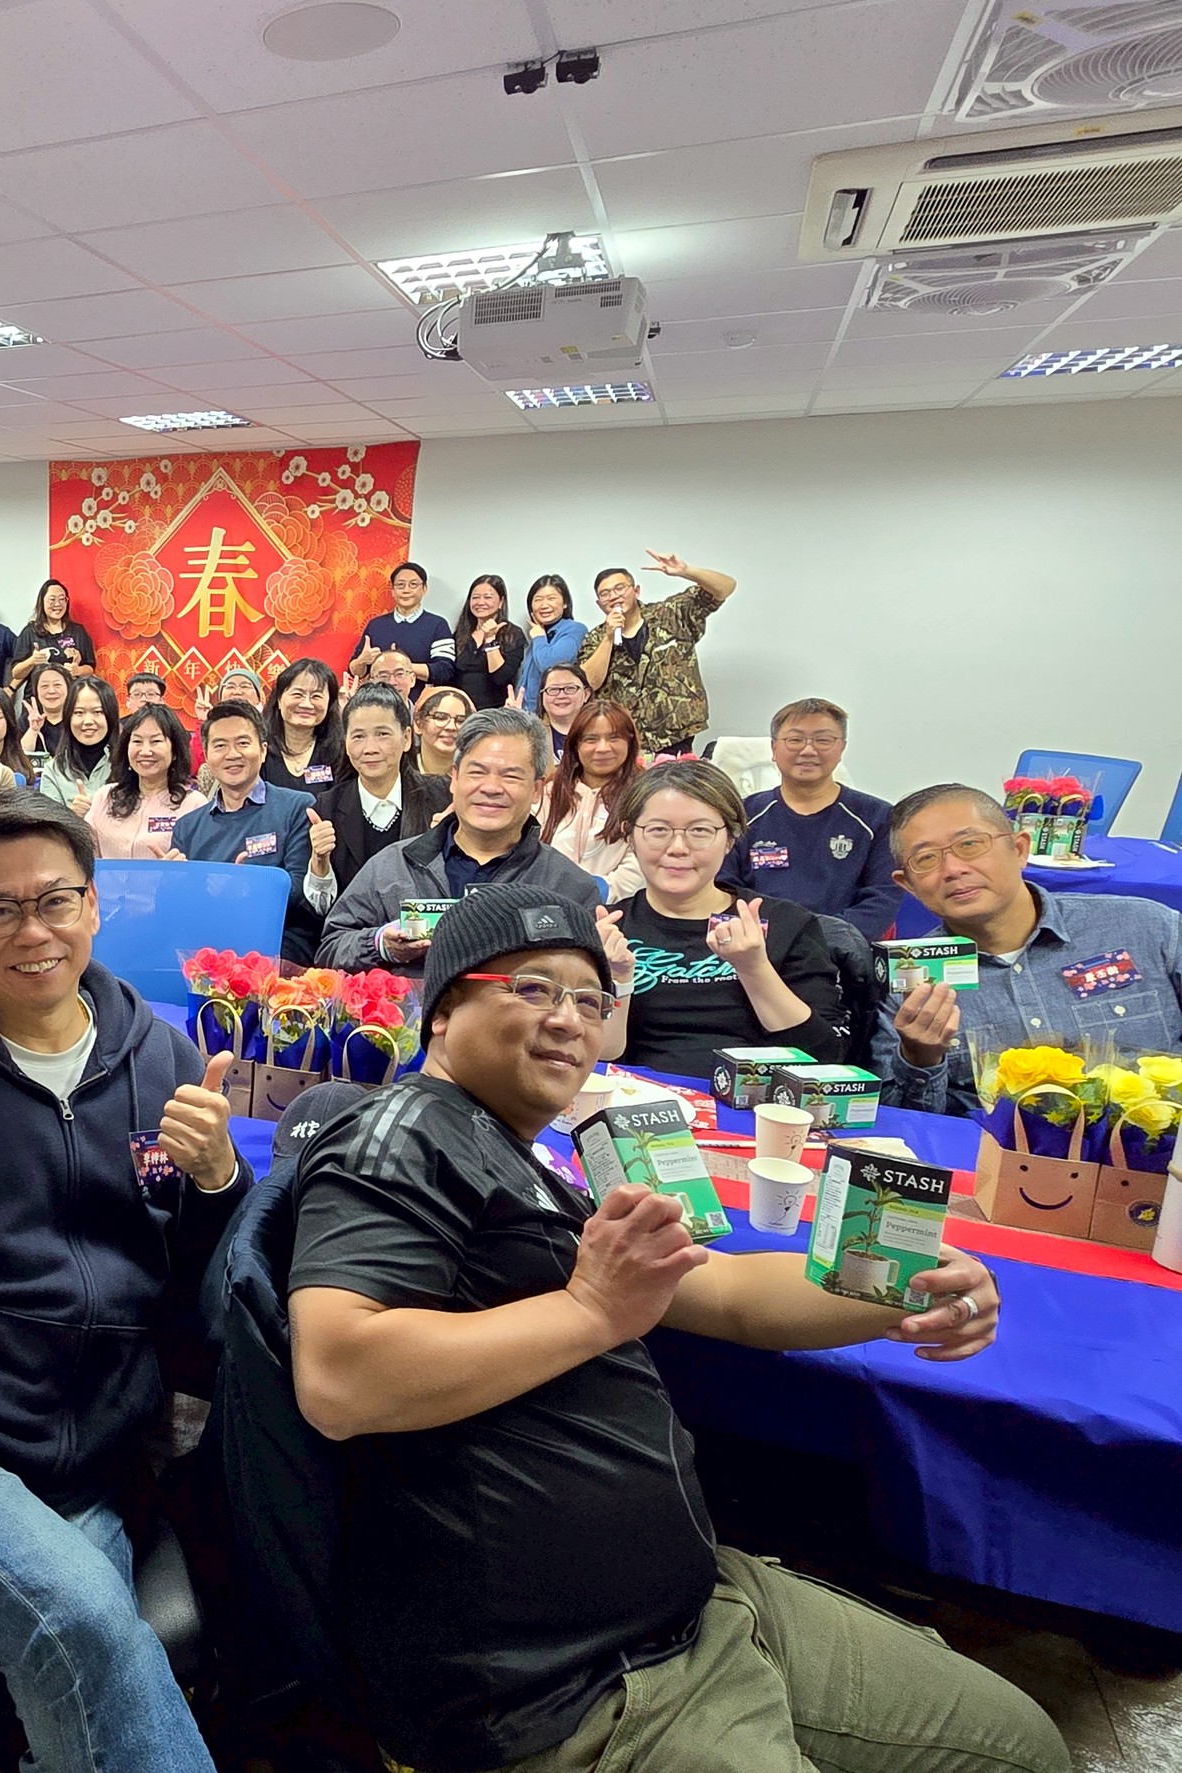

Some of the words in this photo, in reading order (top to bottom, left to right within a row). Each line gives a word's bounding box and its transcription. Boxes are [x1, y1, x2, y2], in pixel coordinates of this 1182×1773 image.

[176, 526, 266, 638] 春
[923, 945, 958, 957] STASH
[661, 974, 689, 984] From
[692, 975, 711, 984] the
[833, 1082, 866, 1093] STASH
[631, 1109, 681, 1127] STASH
[883, 1169, 944, 1193] STASH
[886, 1221, 937, 1238] Peppermint
